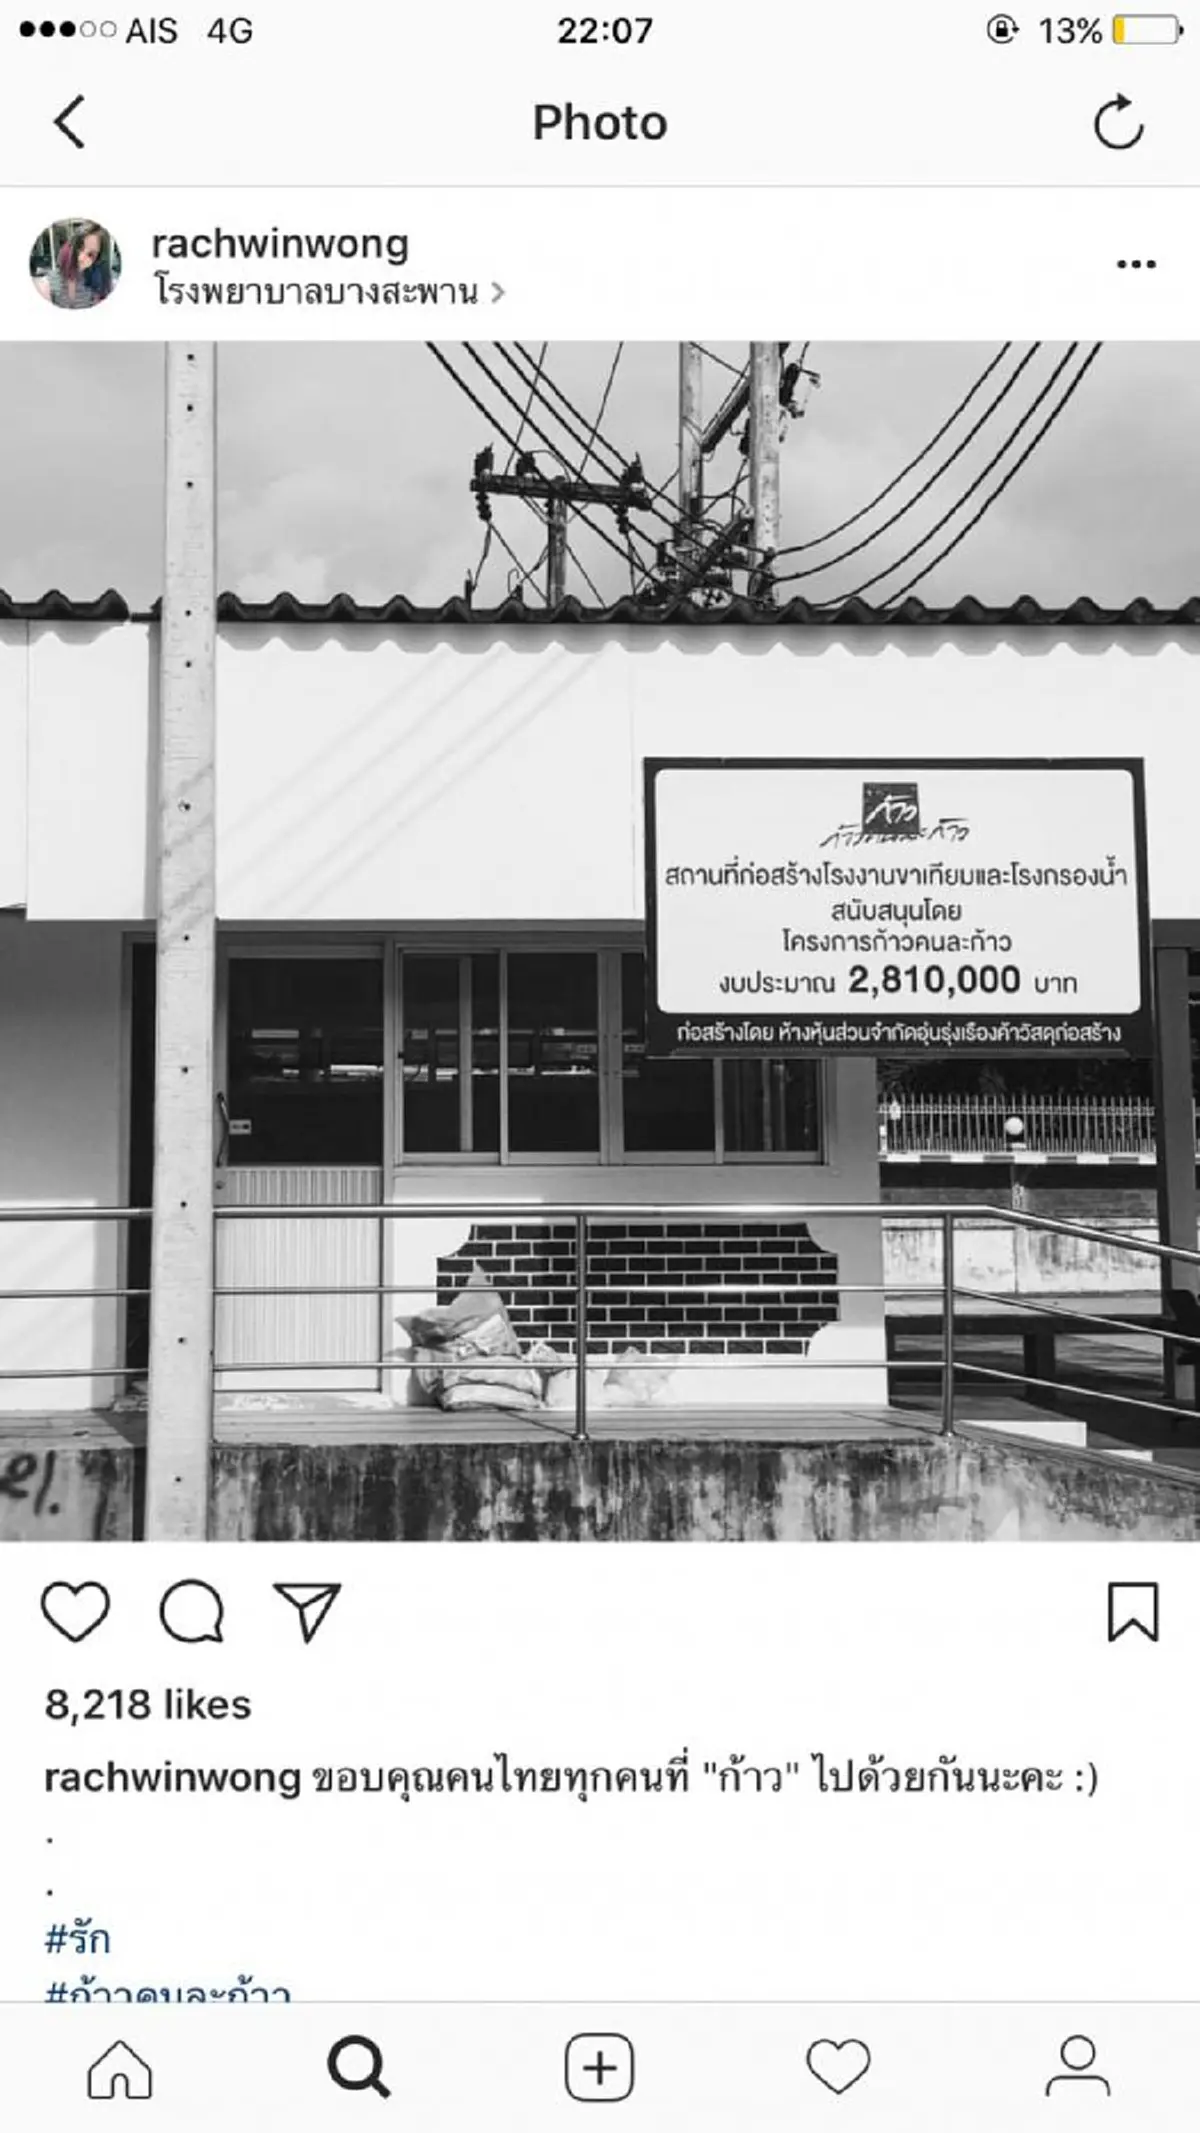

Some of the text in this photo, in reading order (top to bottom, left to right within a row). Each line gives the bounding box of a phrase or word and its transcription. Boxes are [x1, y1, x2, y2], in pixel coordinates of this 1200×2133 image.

[665, 855, 1128, 887] สถานที่ก่อสร้างโรงงานขาเทียมและโรงกรองน้ำ
[831, 897, 962, 927] สนับสนุนโดย
[783, 927, 1013, 953] โครงการก้าวคนละก้าว
[719, 964, 1078, 999] งบประมาณ 2,810,000 บาท
[677, 1020, 774, 1042] ก่อสร้างโดย
